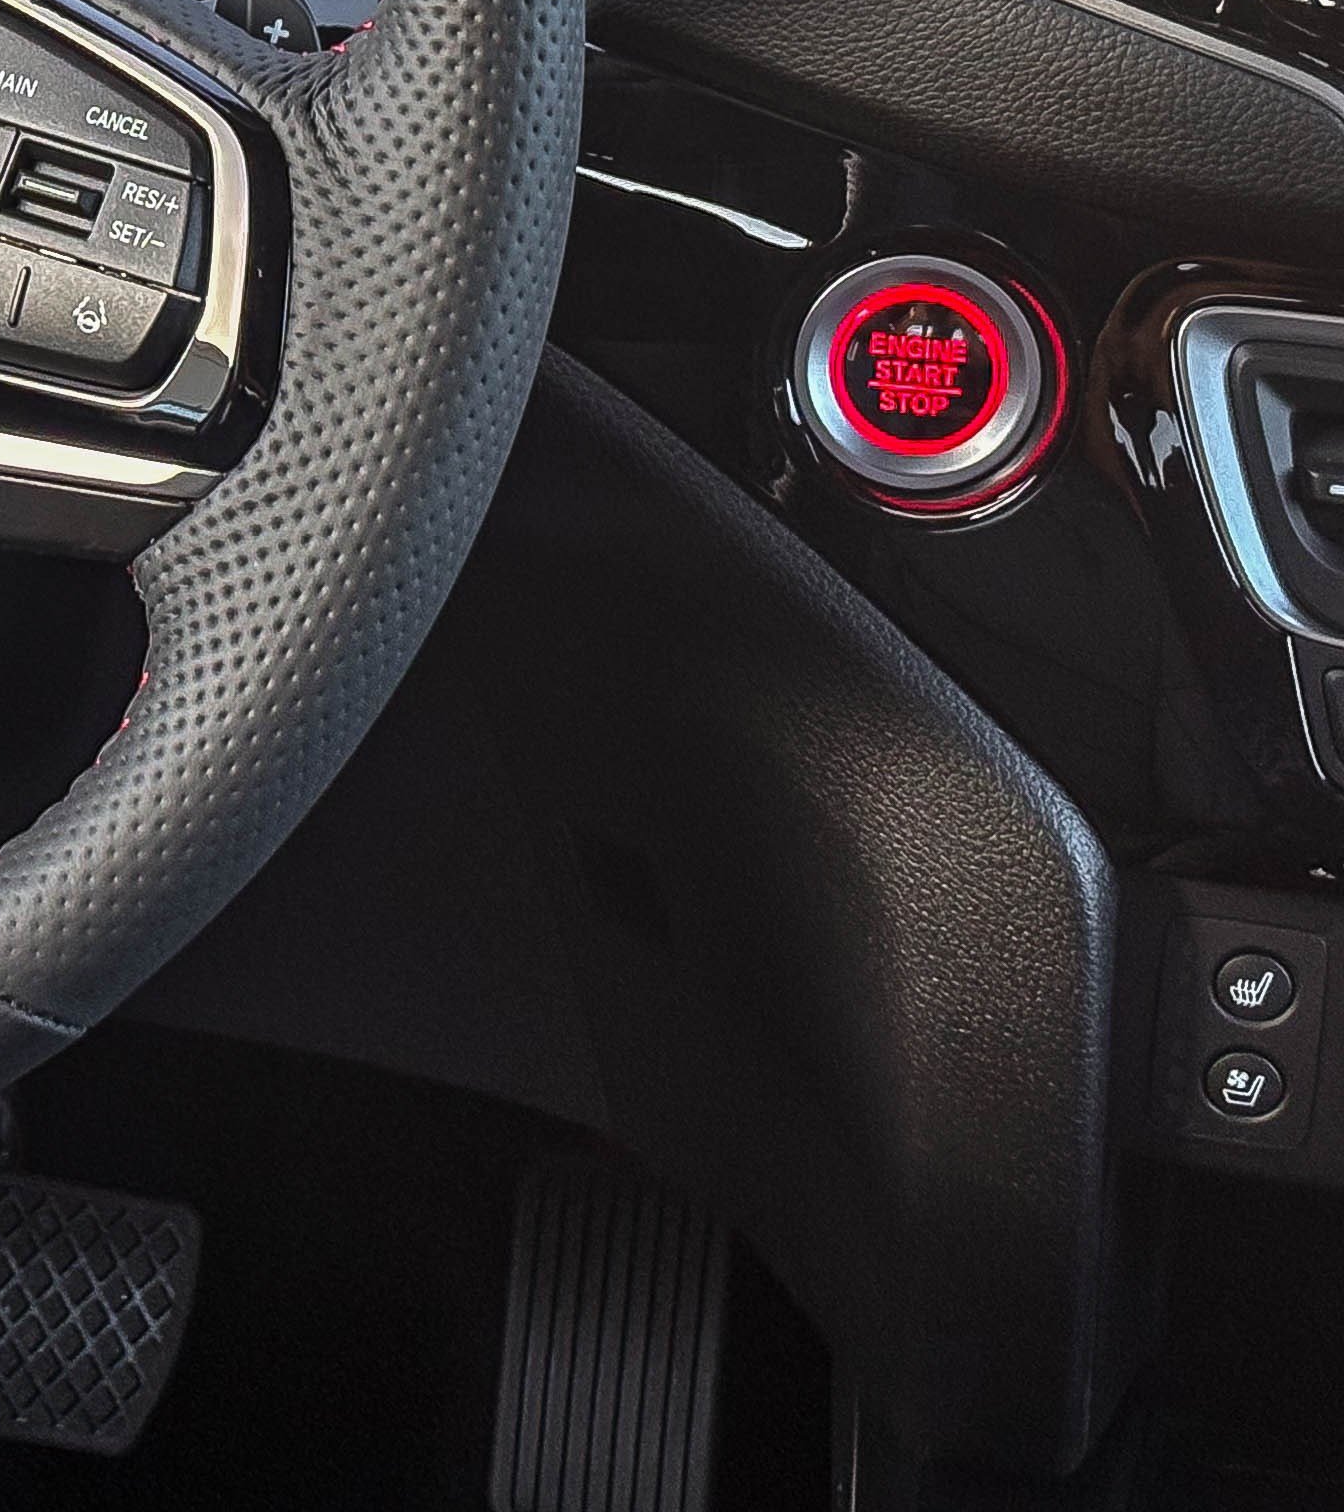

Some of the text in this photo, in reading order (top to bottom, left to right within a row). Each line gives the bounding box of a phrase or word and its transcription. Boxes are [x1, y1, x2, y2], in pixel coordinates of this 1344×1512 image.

[85, 105, 150, 141] CANCEL
[121, 181, 181, 214] RES/+
[868, 330, 969, 364] ENGINE
[875, 359, 959, 387] START
[879, 390, 950, 417] STOP
